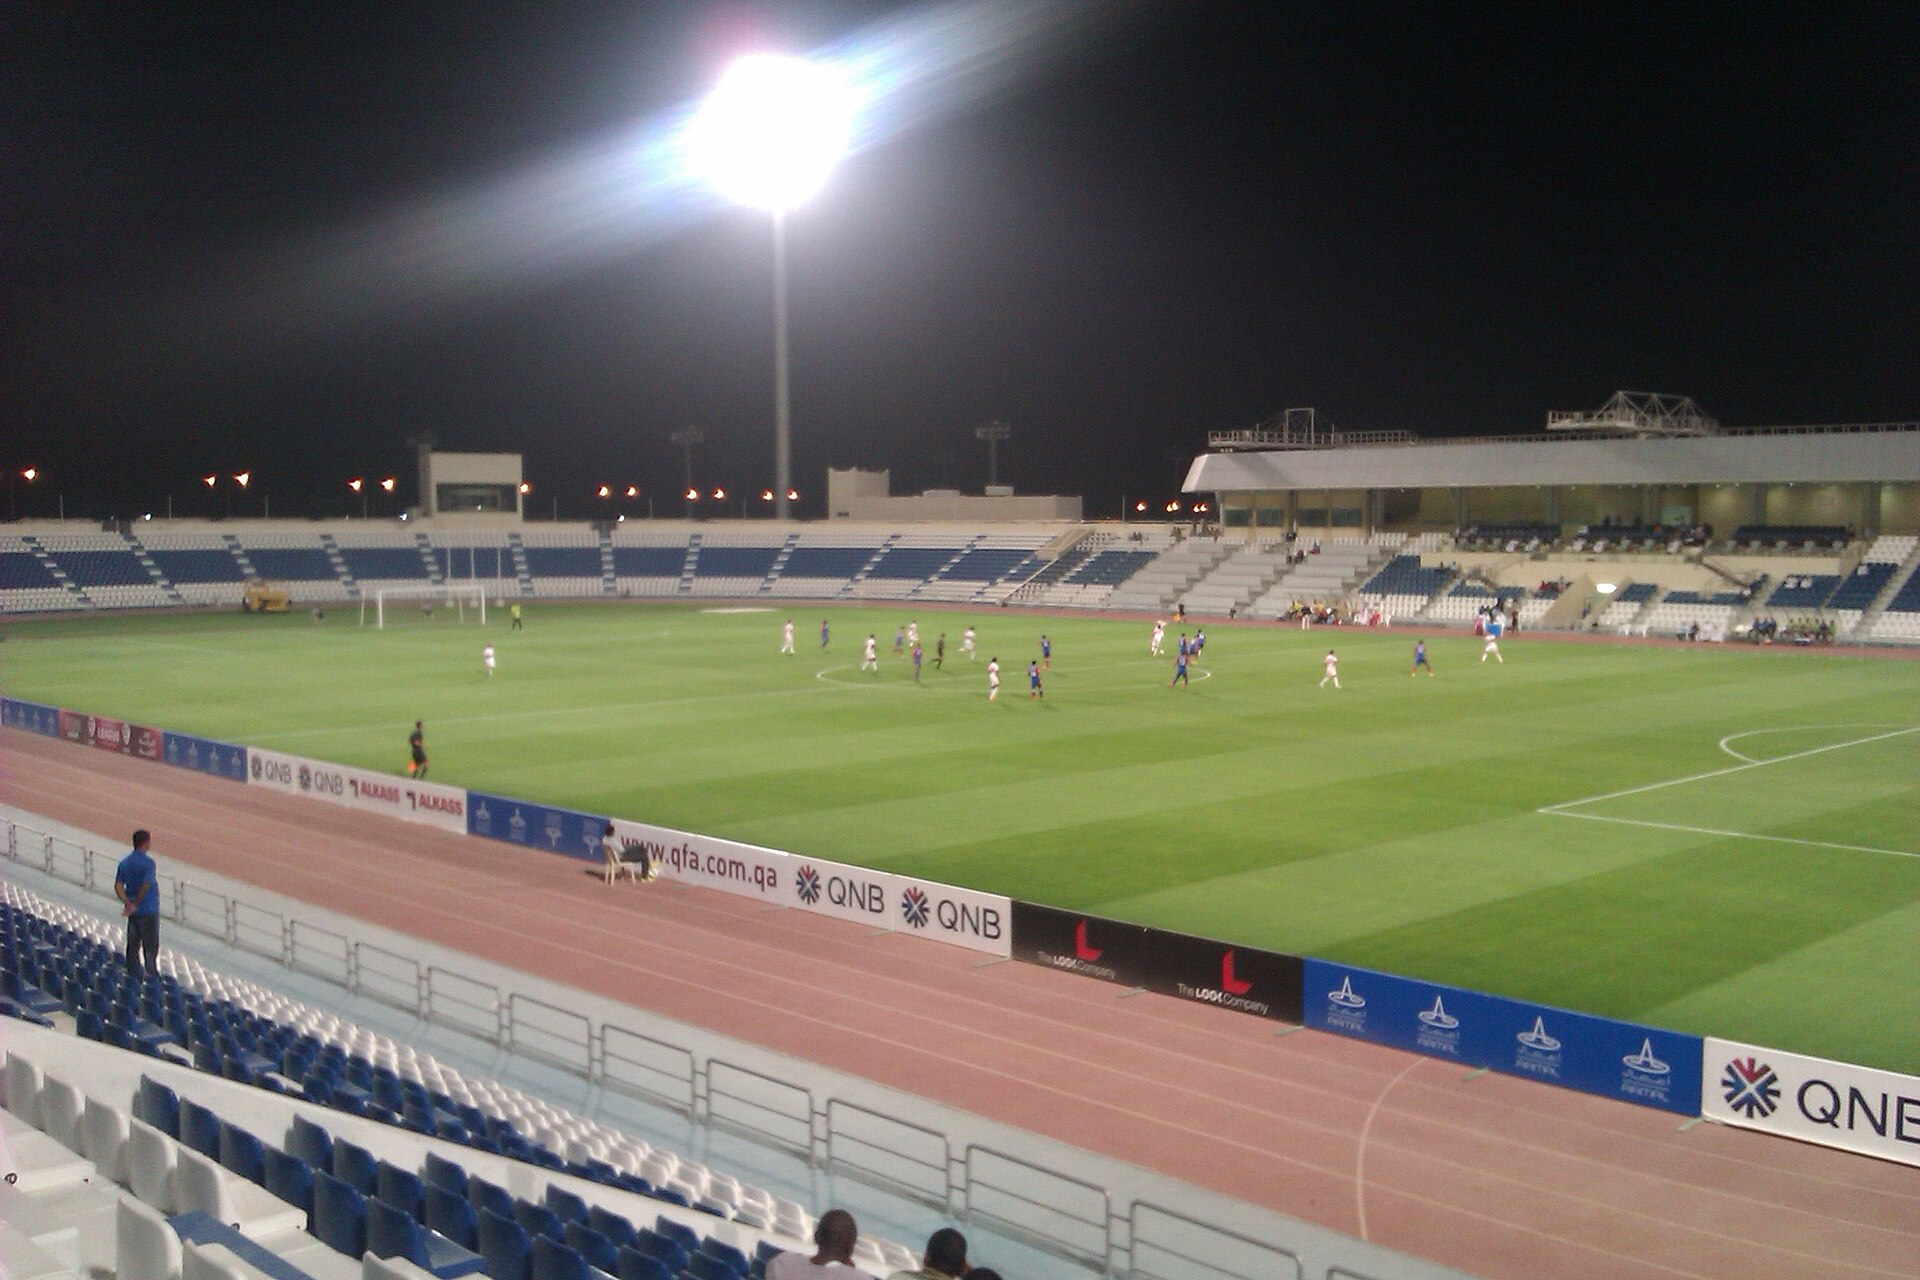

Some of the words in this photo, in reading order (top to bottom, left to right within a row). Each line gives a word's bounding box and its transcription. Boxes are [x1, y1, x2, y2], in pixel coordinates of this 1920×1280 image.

[265, 760, 292, 784] QNB
[314, 771, 344, 796] QNB
[827, 876, 885, 914] QNB
[937, 899, 1001, 940] QNB
